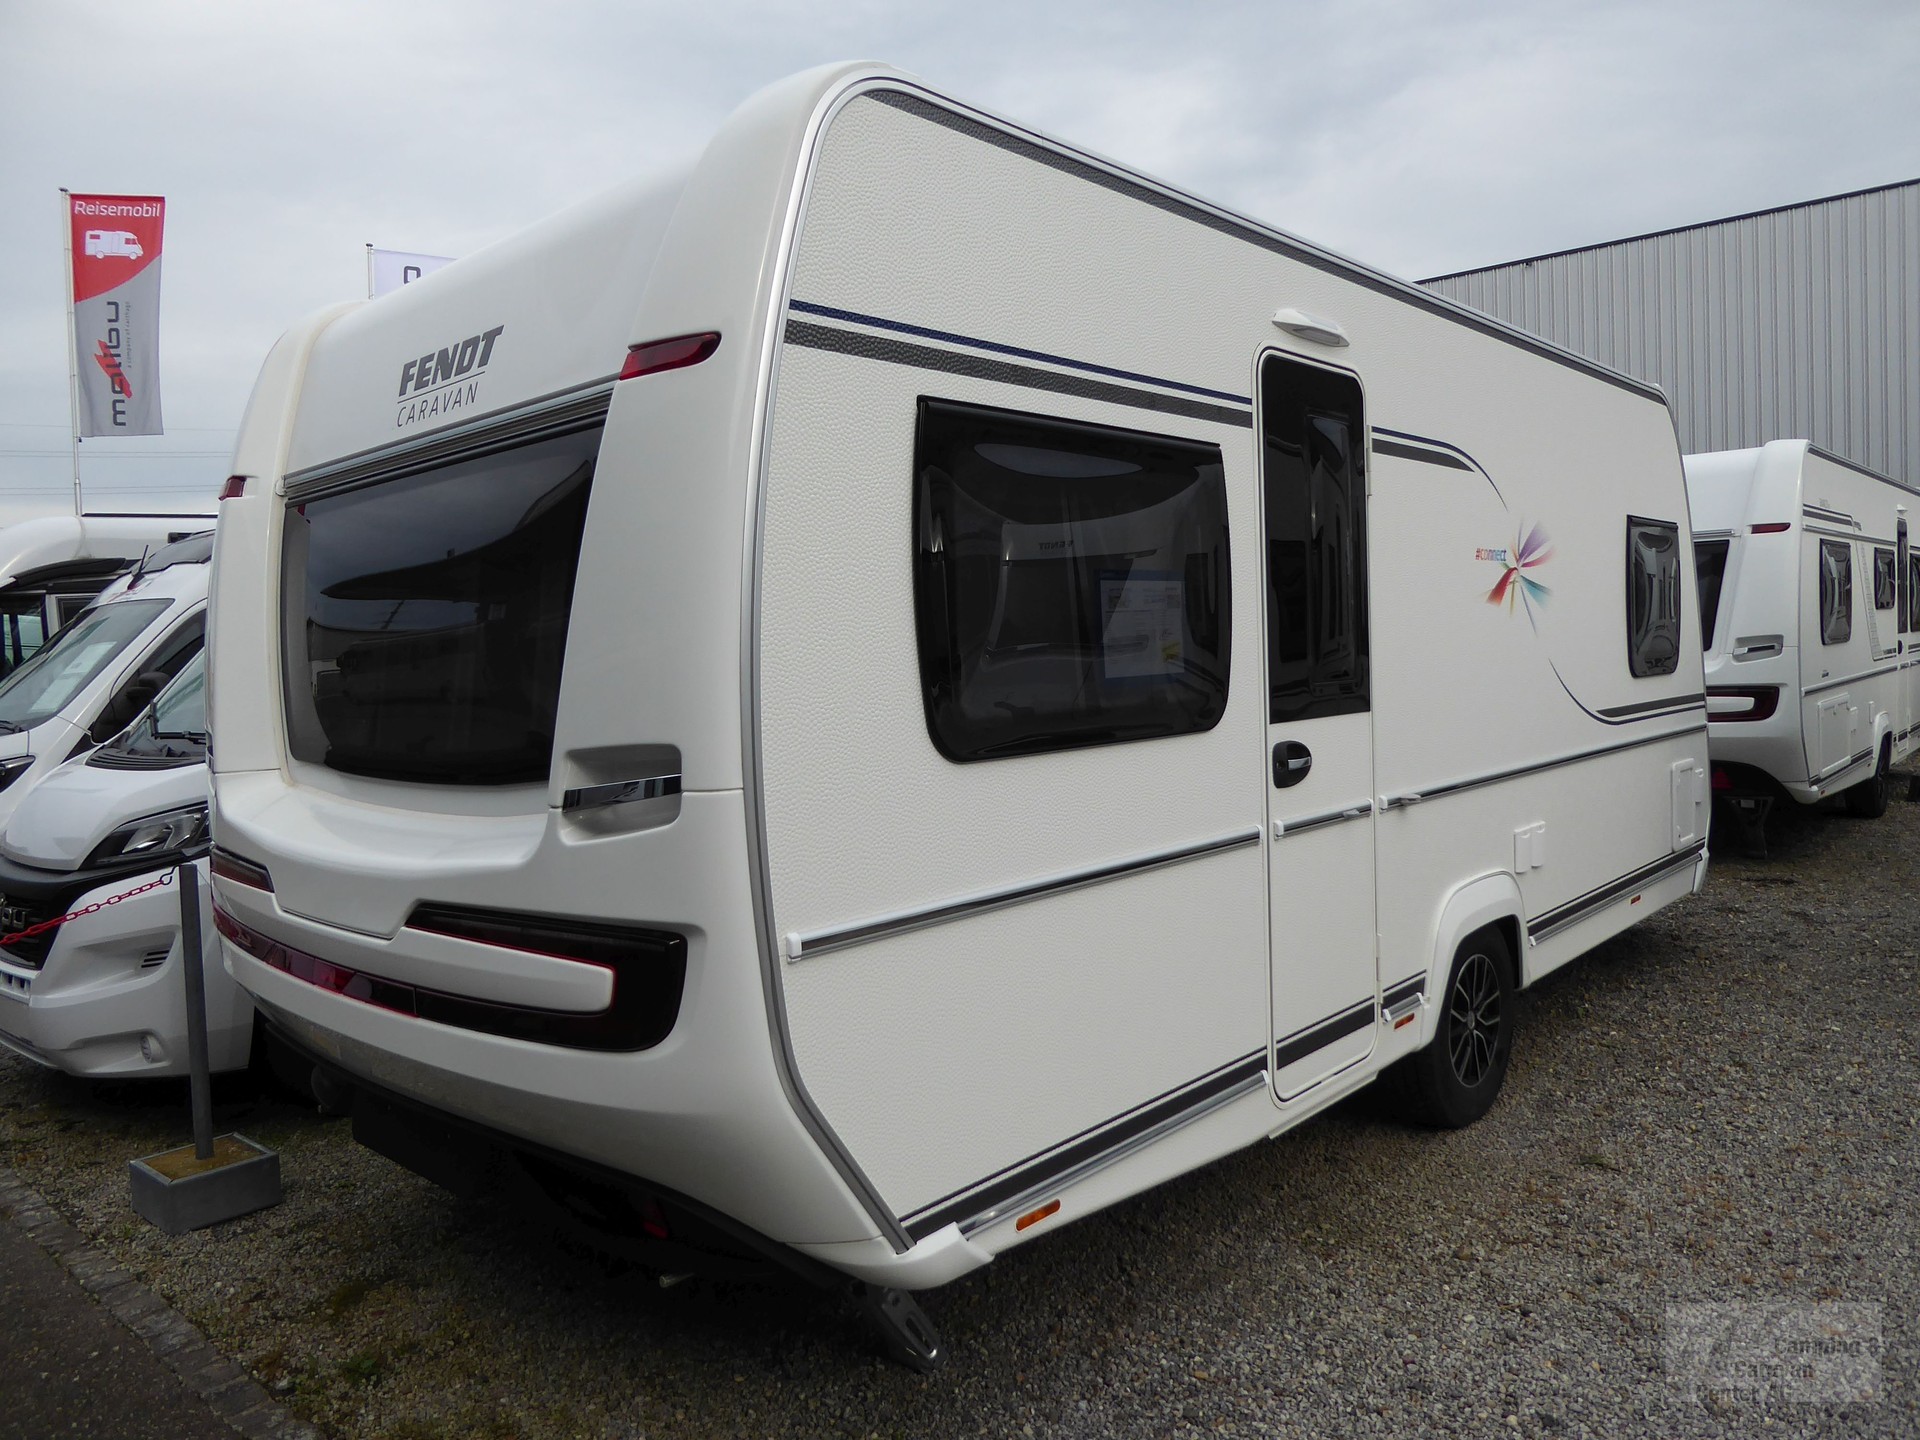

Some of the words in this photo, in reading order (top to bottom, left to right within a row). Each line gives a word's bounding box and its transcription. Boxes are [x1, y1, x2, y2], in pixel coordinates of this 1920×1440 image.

[74, 201, 161, 217] Reisemobil
[104, 301, 127, 427] malibu
[399, 324, 504, 397] FENDT
[397, 381, 478, 428] CARAVAN
